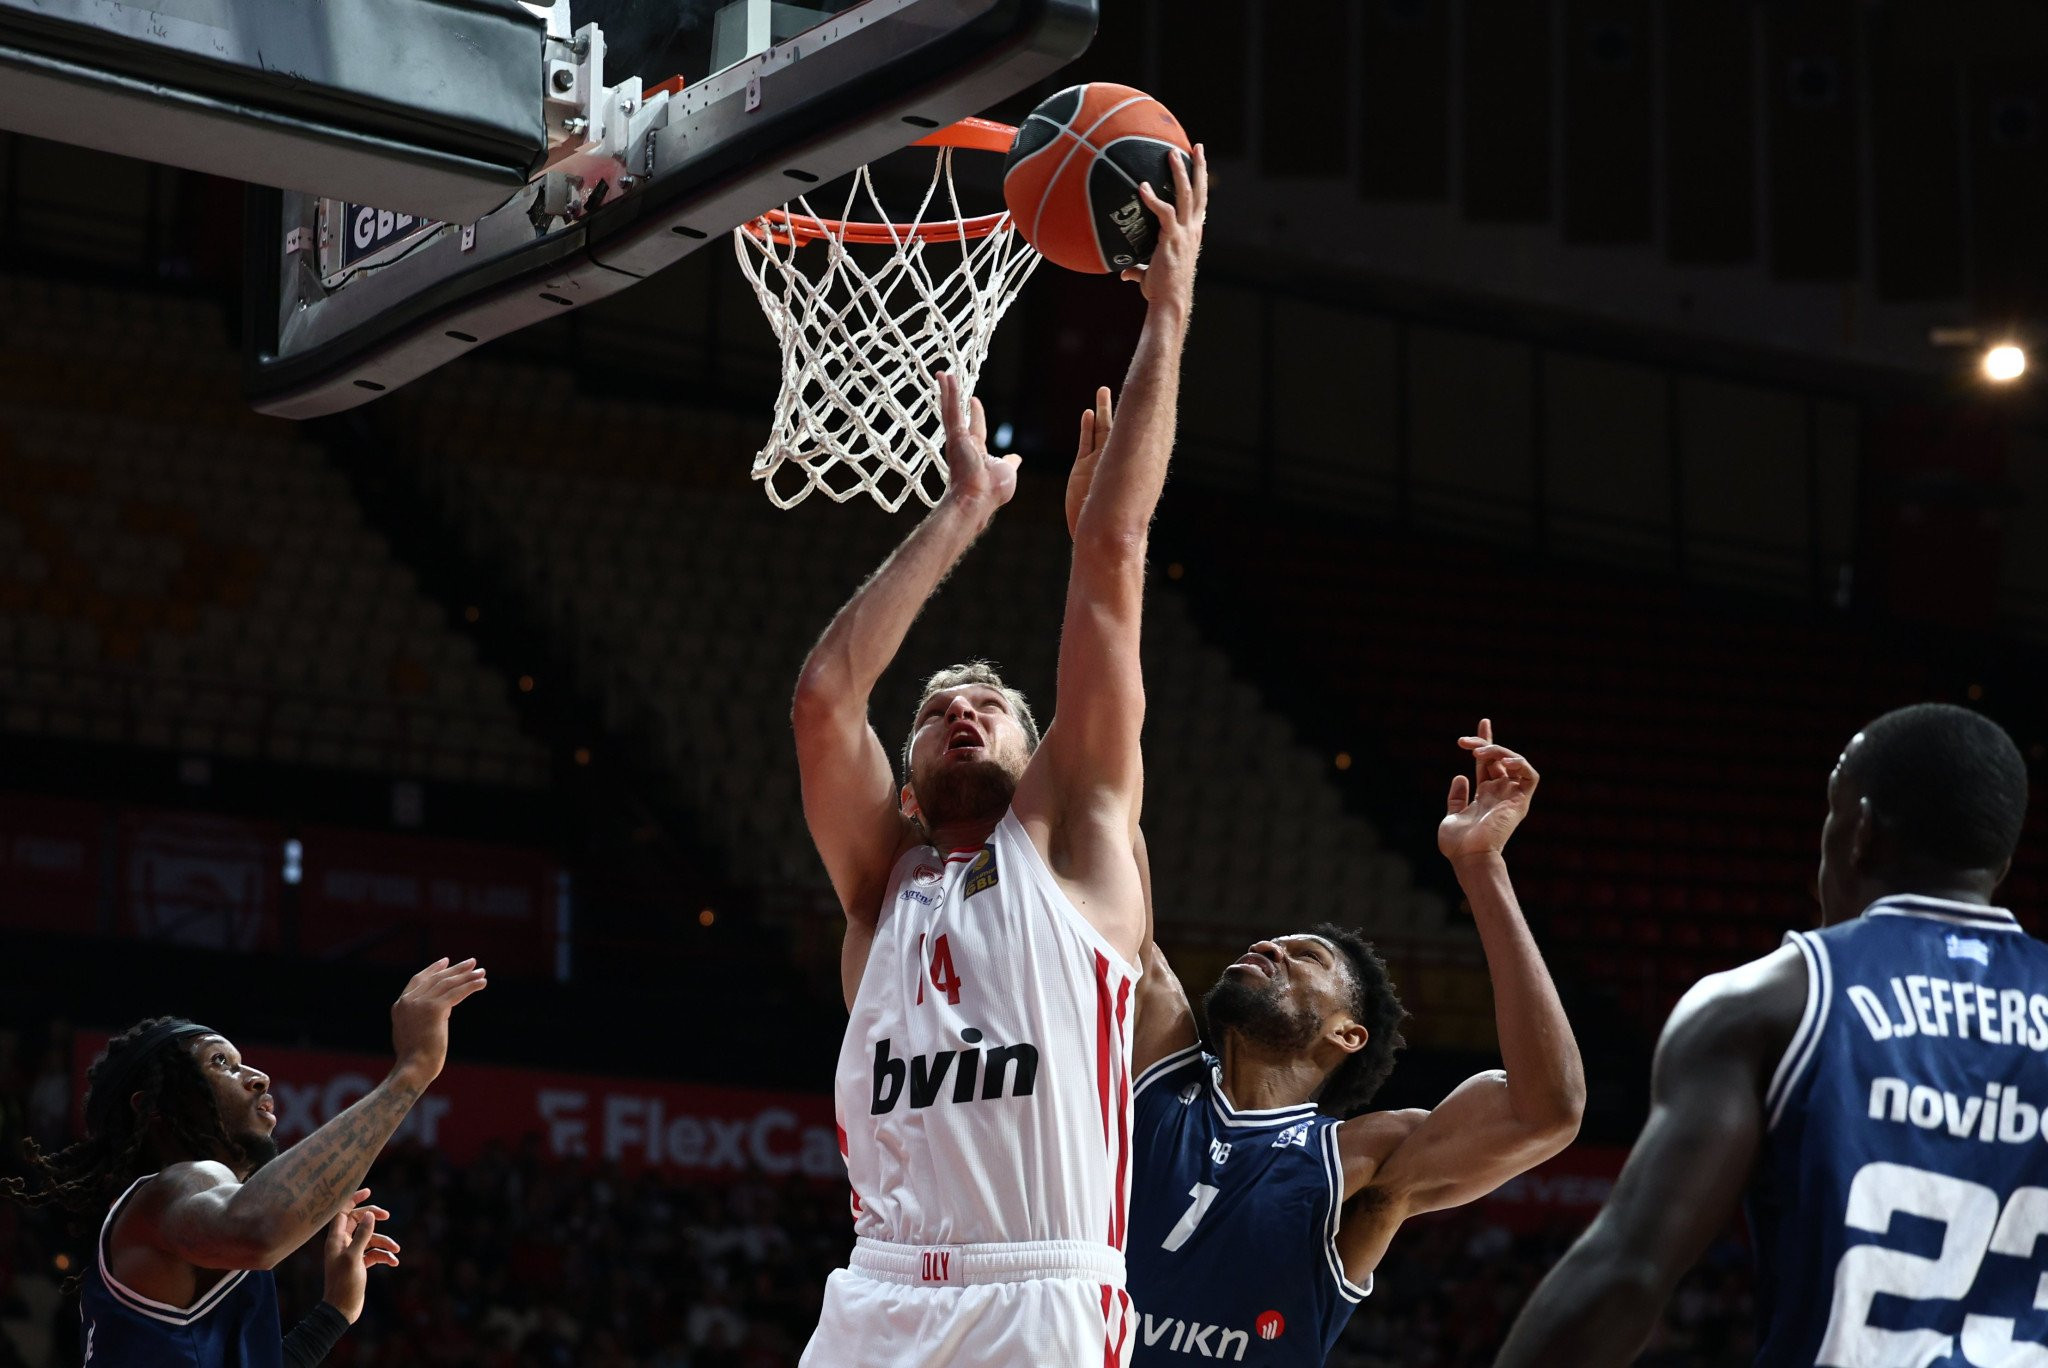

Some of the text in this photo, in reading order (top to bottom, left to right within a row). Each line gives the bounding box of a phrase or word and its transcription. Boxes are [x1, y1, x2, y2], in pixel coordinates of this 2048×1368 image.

[1868, 1076, 2048, 1144] novib
[1161, 1182, 1220, 1252] 1
[922, 1252, 950, 1280] OLY
